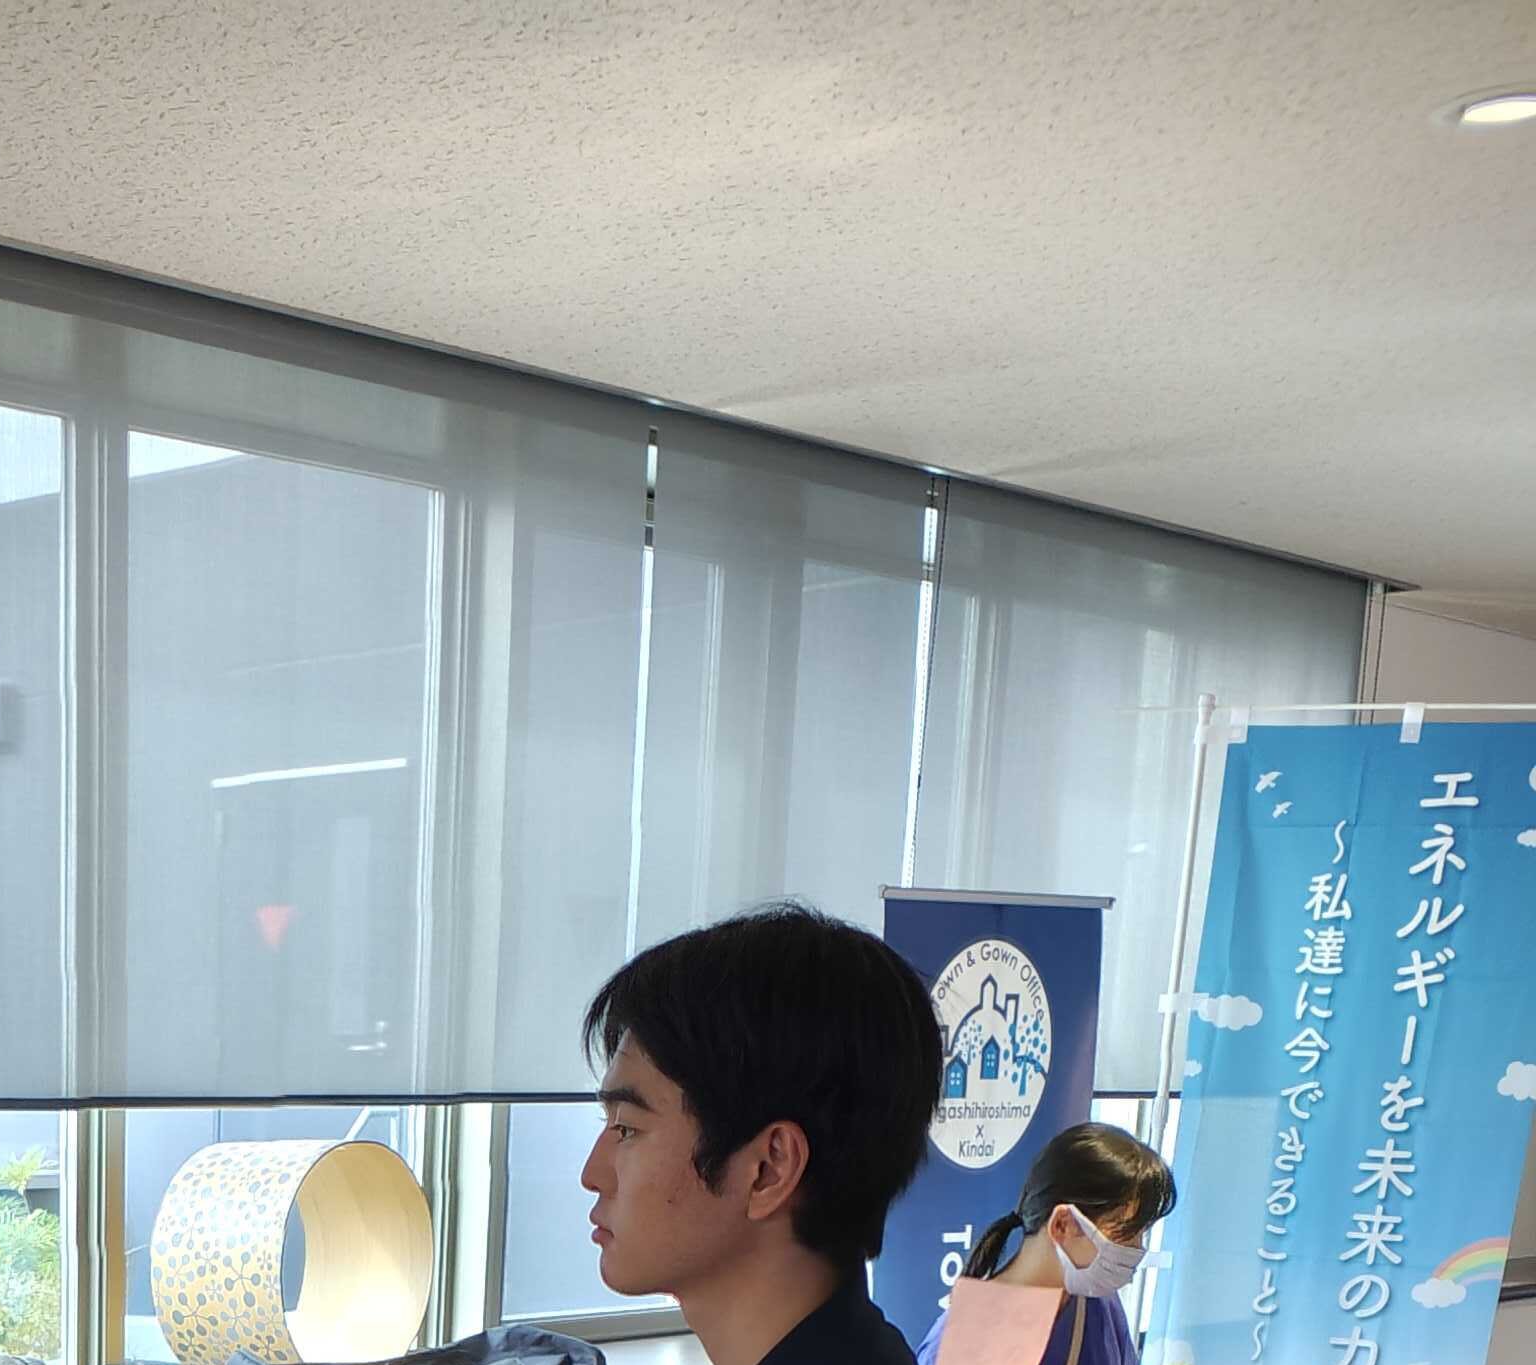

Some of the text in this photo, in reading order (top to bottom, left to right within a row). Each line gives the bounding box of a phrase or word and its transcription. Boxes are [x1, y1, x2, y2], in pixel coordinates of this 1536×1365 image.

[980, 942, 1018, 970] Gown
[937, 1101, 1031, 1124] gashihiroshima
[958, 1140, 994, 1158] Kindai
